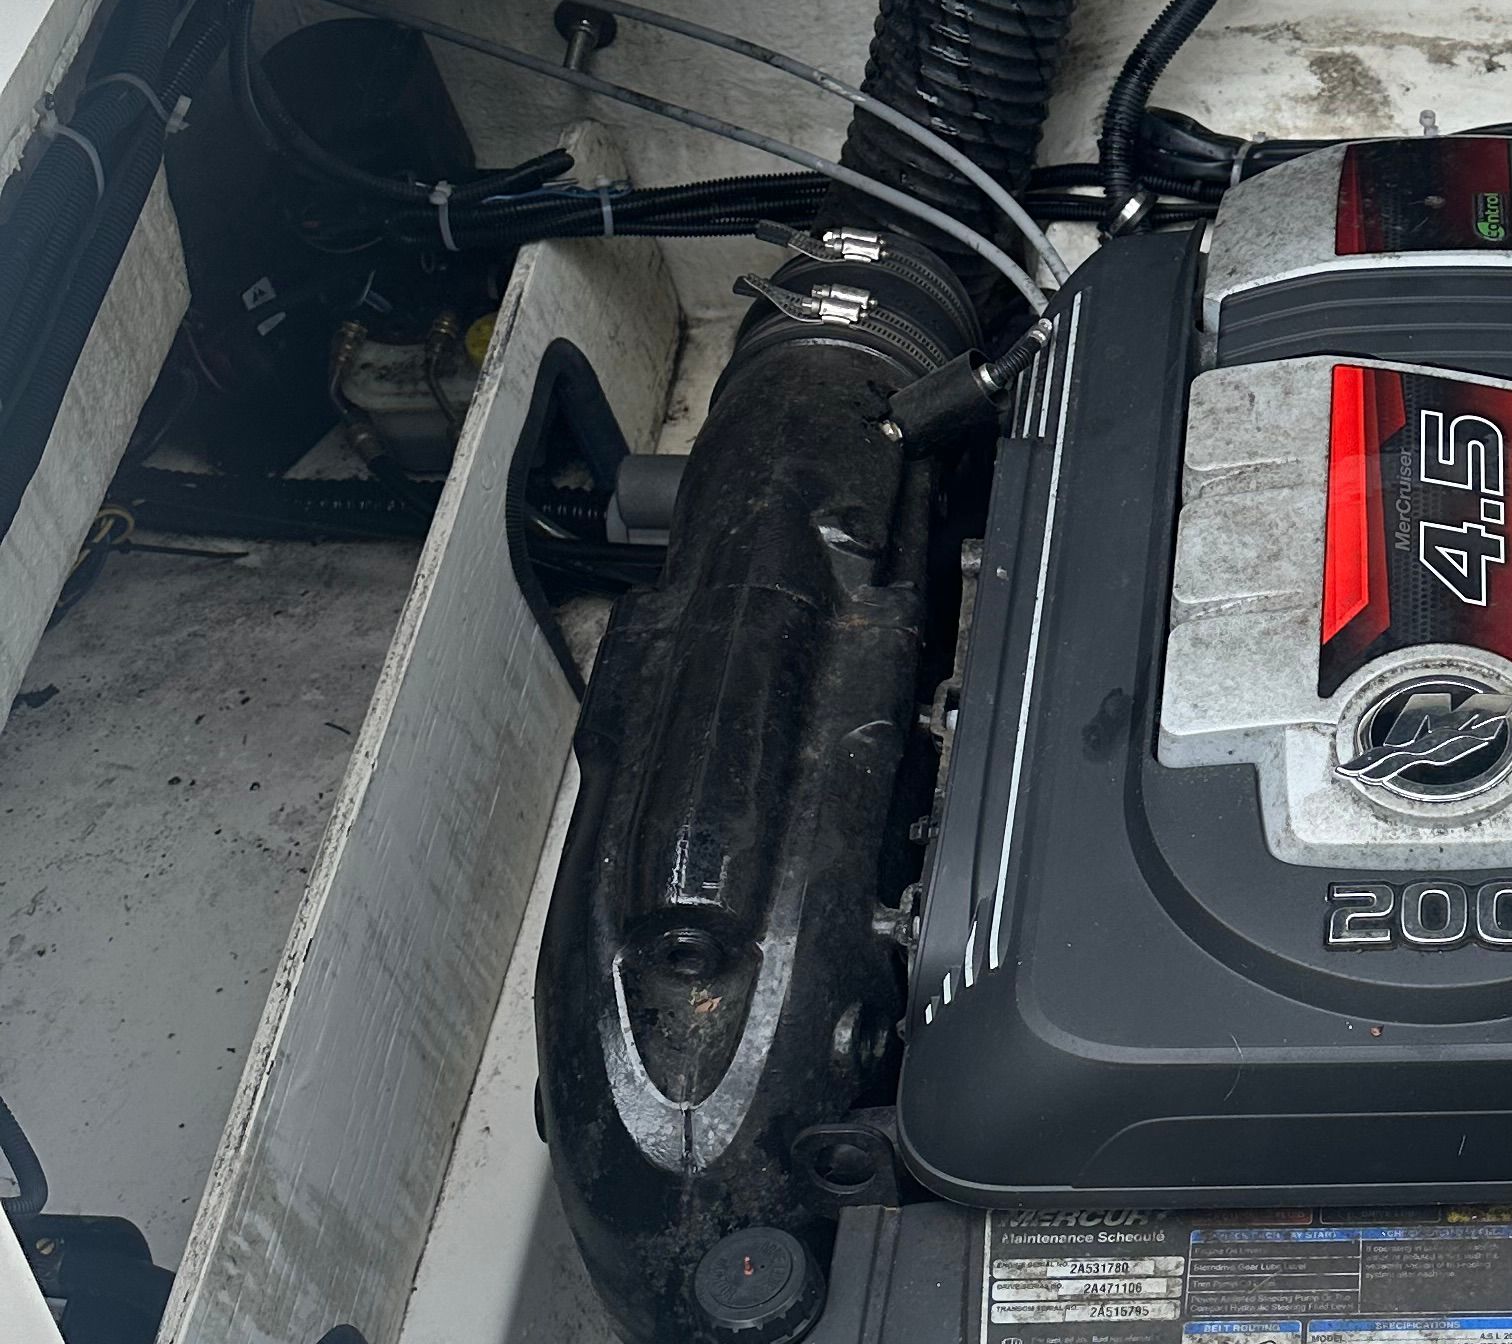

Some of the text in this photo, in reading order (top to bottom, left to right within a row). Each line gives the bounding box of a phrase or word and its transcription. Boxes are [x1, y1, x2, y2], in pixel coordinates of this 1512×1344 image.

[1394, 447, 1412, 551] MerCruiser
[1418, 409, 1505, 606] 4.5
[1070, 1263, 1129, 1274] 2A531780
[1084, 1283, 1142, 1294] 2A471106
[1203, 1324, 1280, 1333] BELT ROUTING
[1375, 1321, 1461, 1329] SPECIFICATIONS
